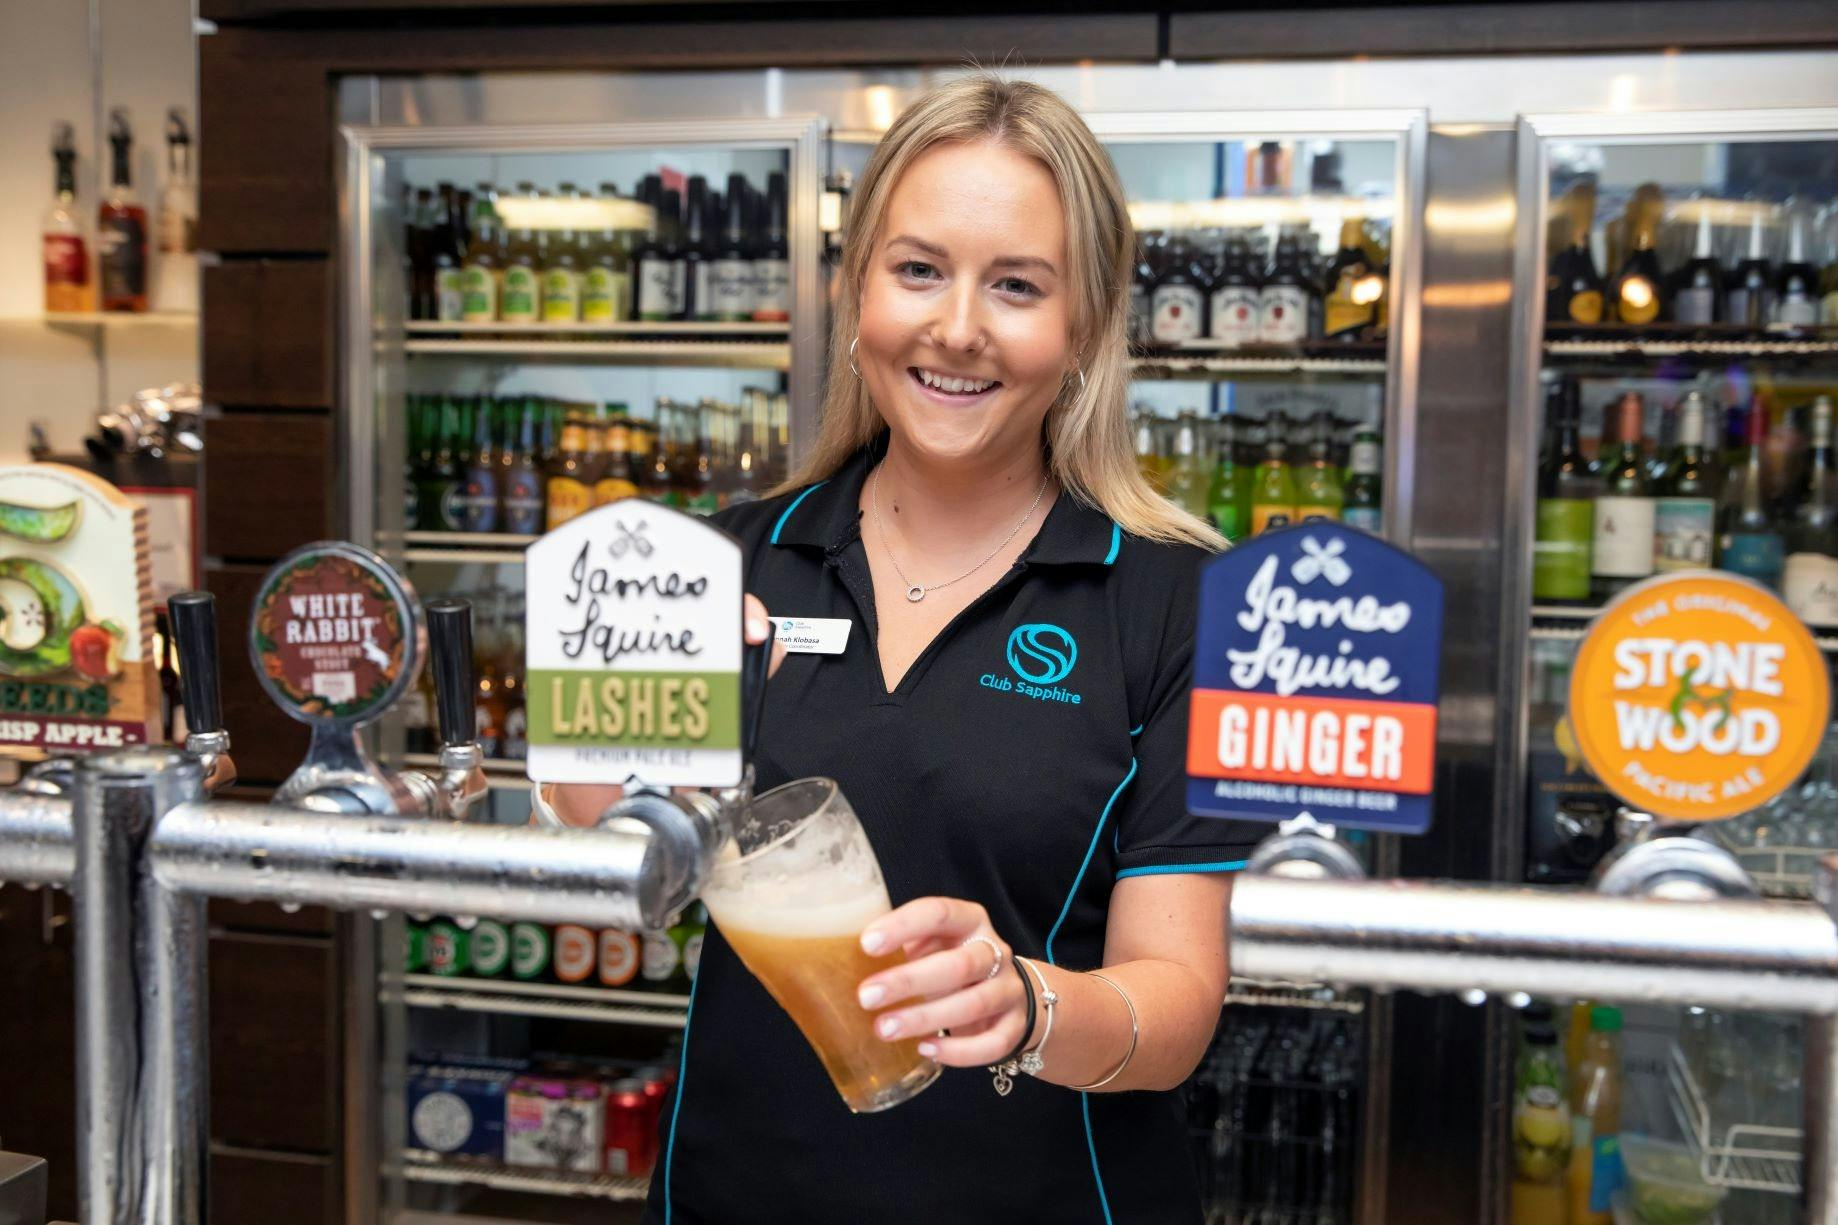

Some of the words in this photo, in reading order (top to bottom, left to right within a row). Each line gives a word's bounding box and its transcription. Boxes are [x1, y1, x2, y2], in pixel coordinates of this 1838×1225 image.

[565, 540, 709, 604] James
[1237, 553, 1412, 632] James
[286, 617, 375, 643] RABBIT
[289, 592, 364, 618] WHITE
[559, 598, 703, 663] Squire
[793, 636, 819, 644] Klobasa
[1226, 620, 1401, 697] Squire
[1613, 637, 1785, 697] STONE
[551, 676, 710, 741] LASHES
[980, 673, 1013, 692] Club
[1014, 681, 1082, 705] Sapphire
[44, 721, 123, 747] APPLE
[1217, 703, 1404, 782] GINGER
[1614, 700, 1781, 757] WOOD
